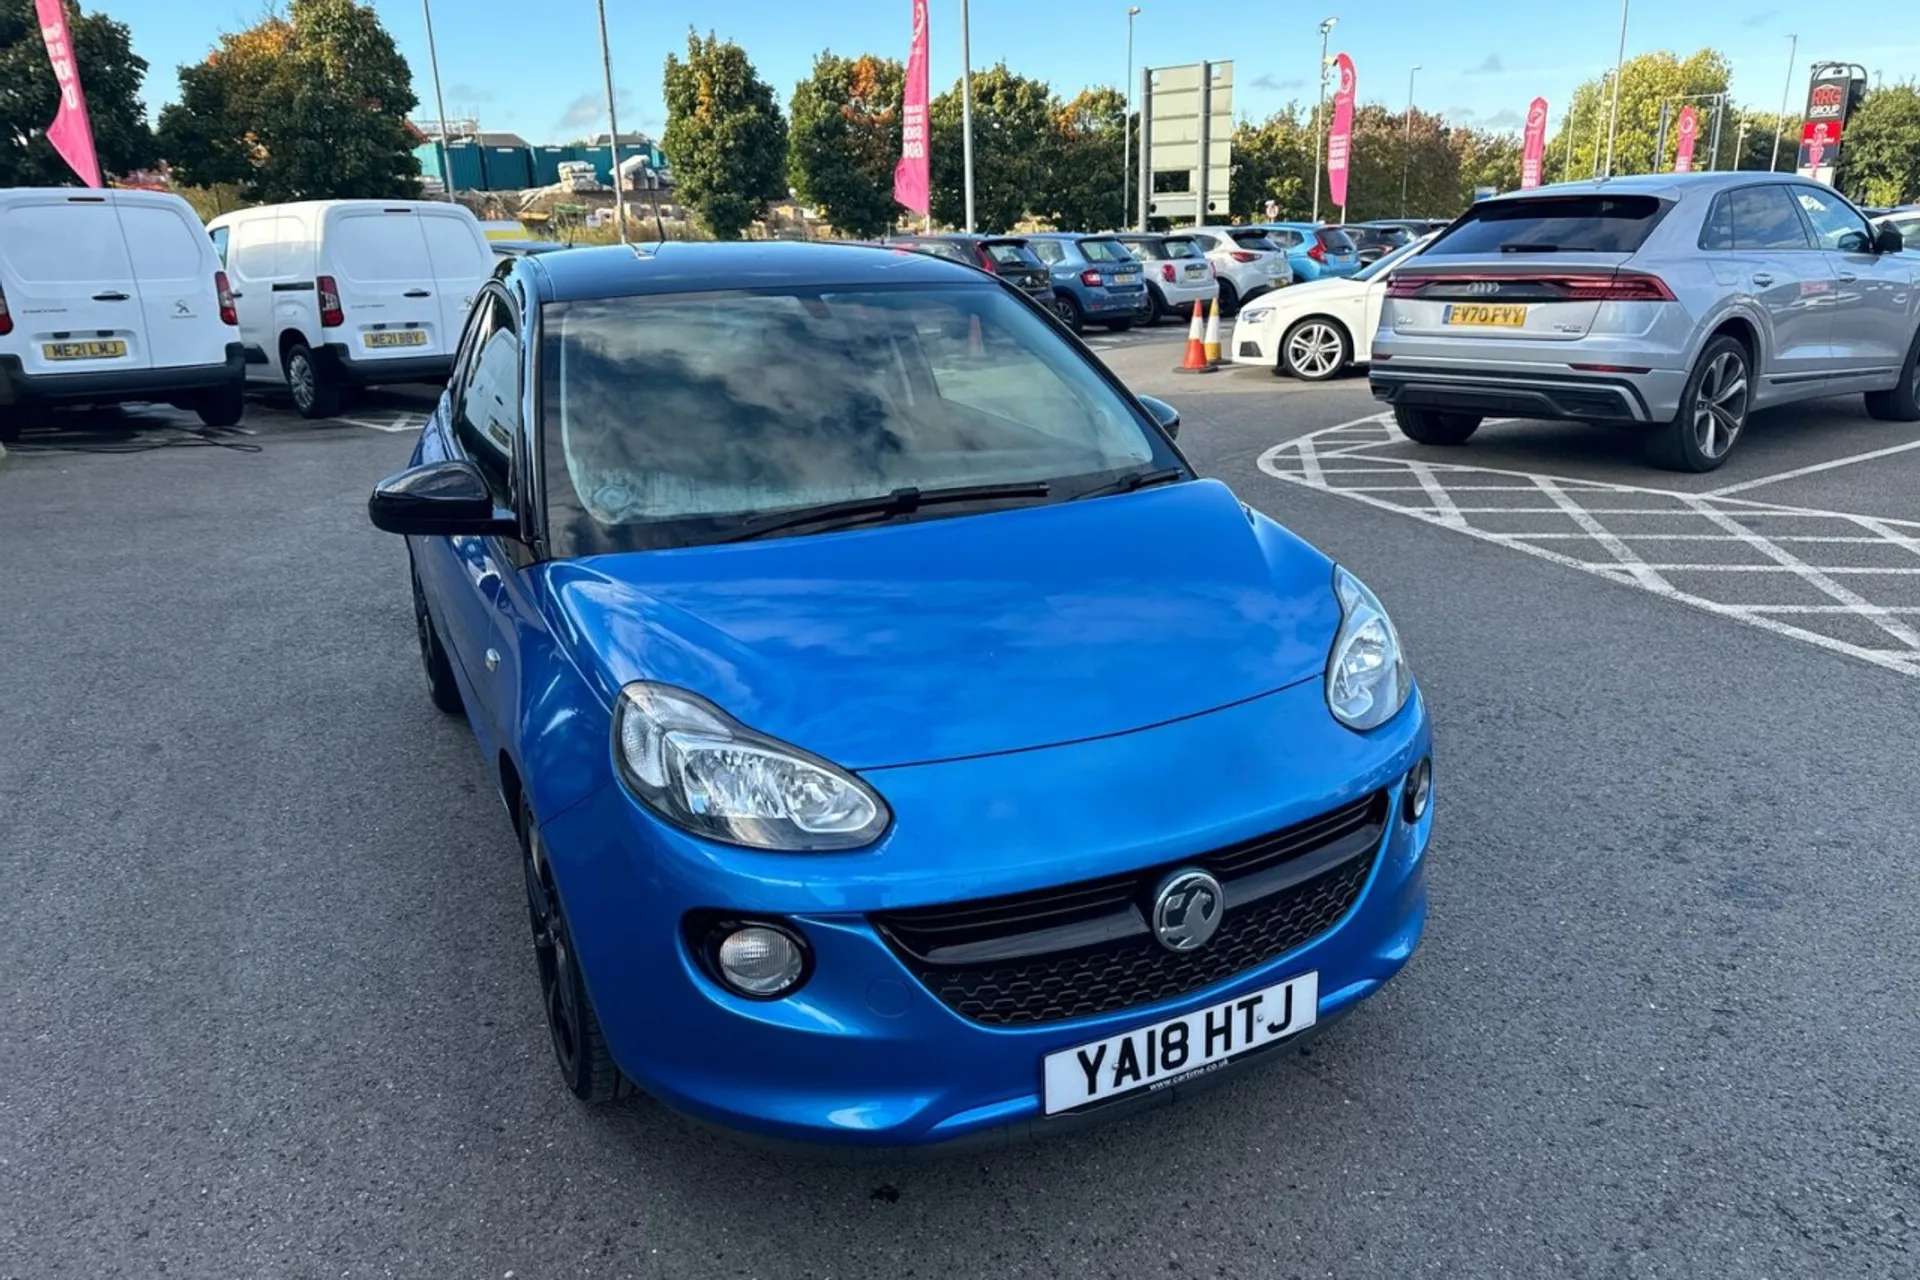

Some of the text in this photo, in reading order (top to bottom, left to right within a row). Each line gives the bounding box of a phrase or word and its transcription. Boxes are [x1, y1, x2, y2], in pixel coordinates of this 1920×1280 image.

[1812, 88, 1841, 106] RRG
[1810, 104, 1840, 115] GROUP
[1450, 306, 1488, 322] FV70
[1077, 984, 1293, 1095] YA18 HTJ
